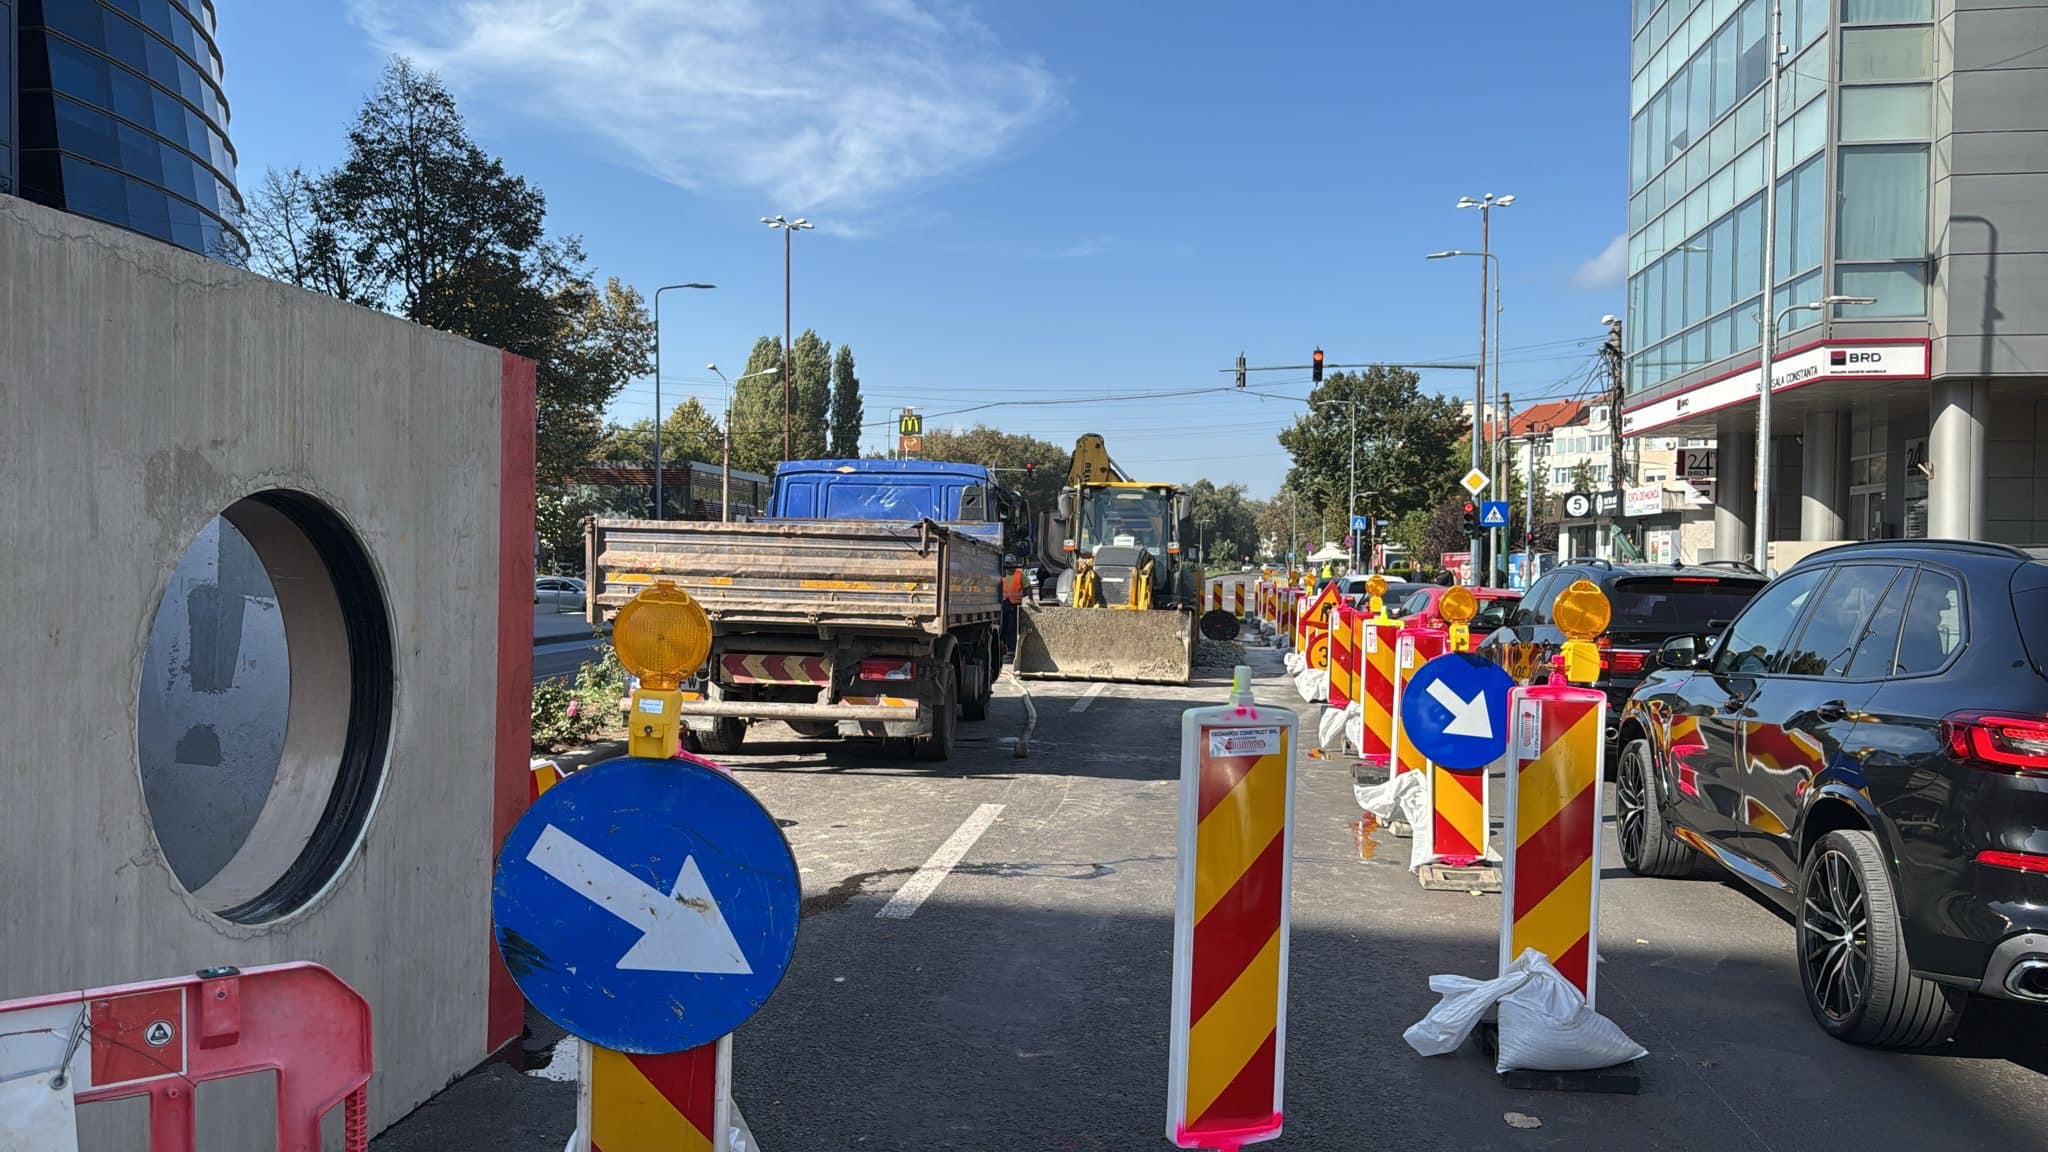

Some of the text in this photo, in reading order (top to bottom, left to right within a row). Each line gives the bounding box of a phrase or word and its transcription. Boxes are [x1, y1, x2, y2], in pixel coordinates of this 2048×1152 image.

[1849, 353, 1881, 363] BRD
[1573, 498, 1582, 511] 5
[1318, 646, 1328, 667] 3
